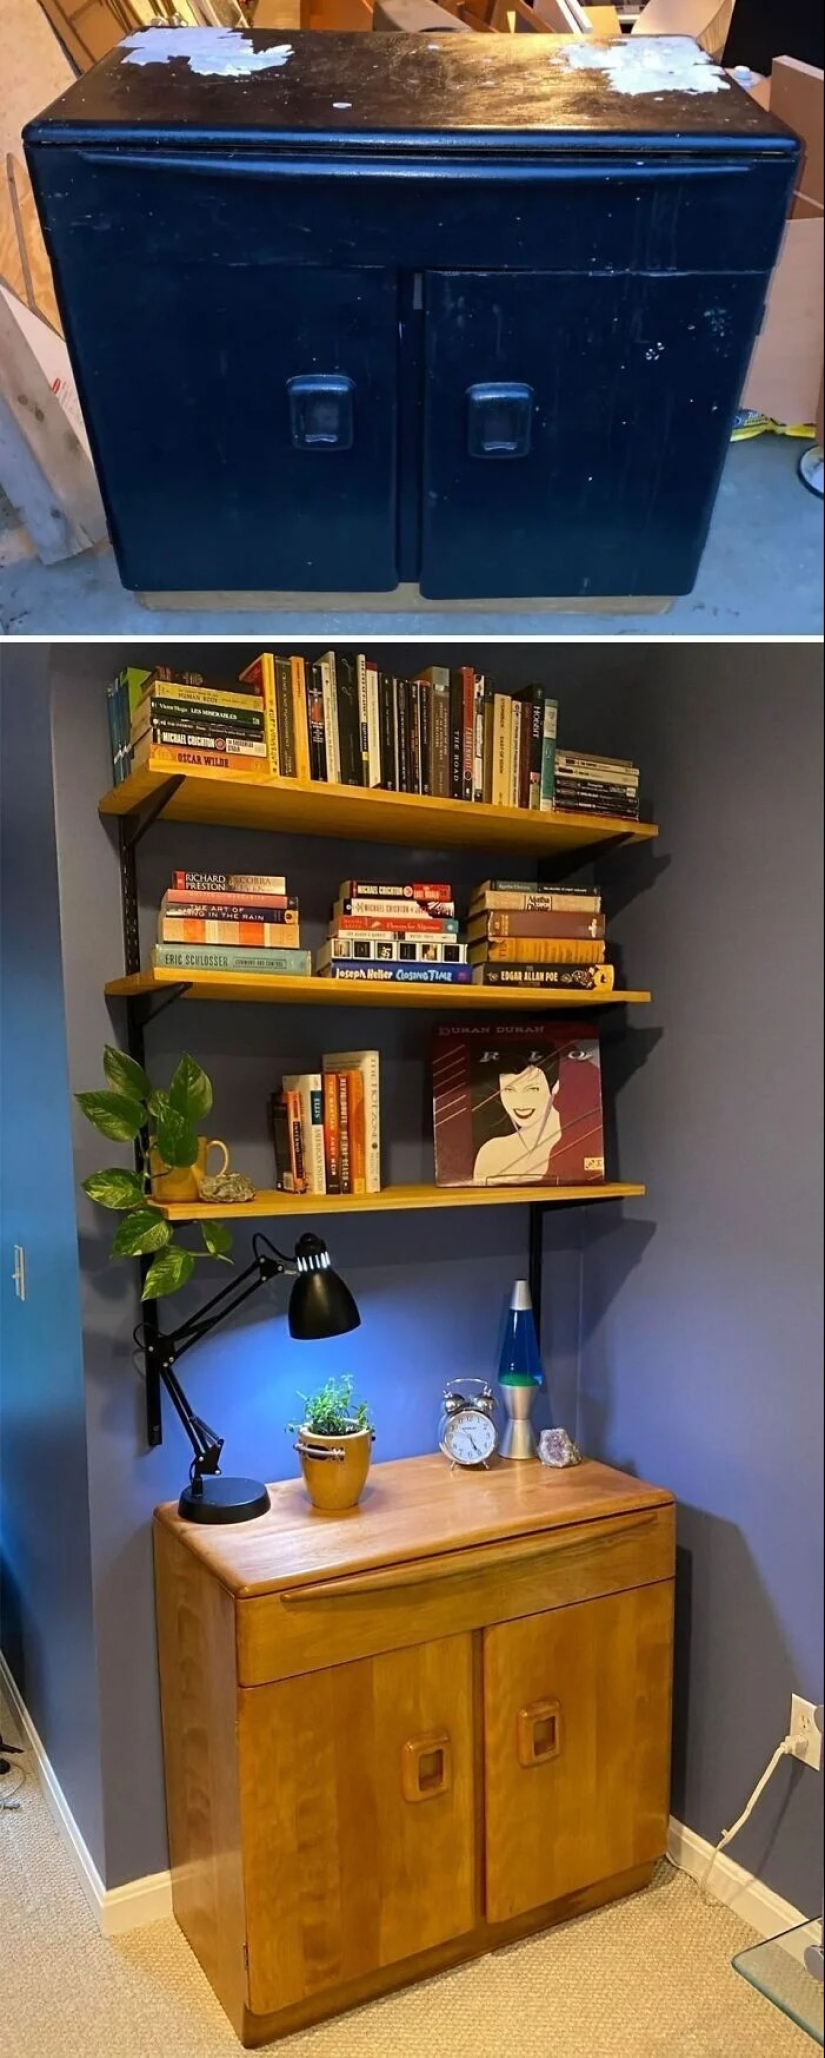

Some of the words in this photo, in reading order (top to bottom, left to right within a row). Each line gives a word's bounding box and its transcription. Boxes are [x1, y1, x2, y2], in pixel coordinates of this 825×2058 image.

[162, 731, 187, 745] MICHAEL
[187, 735, 215, 748] CRICHTON
[464, 726, 473, 769] FAHRENHEIT
[177, 752, 202, 765] OSCAR
[203, 756, 229, 768] WILDE
[185, 873, 226, 884] RICHARD
[185, 882, 226, 891] PRESTON
[357, 885, 379, 895] MICHAEL
[378, 886, 403, 896] CRICHTON
[190, 904, 208, 912] THE
[364, 903, 385, 913] MICHAEL
[385, 904, 409, 914] CRICHTON
[165, 954, 182, 965] ERIC
[185, 955, 228, 967] SCHLOSSER
[335, 968, 366, 980] Joseph
[366, 968, 393, 980] Heller
[428, 969, 453, 982] TIME
[500, 970, 523, 982] EDGAR
[523, 971, 545, 982] ALLAN
[545, 971, 559, 983] POE
[438, 1026, 490, 1036] DURAN
[495, 1026, 545, 1034] DURAN
[313, 1097, 321, 1119] ELLIS
